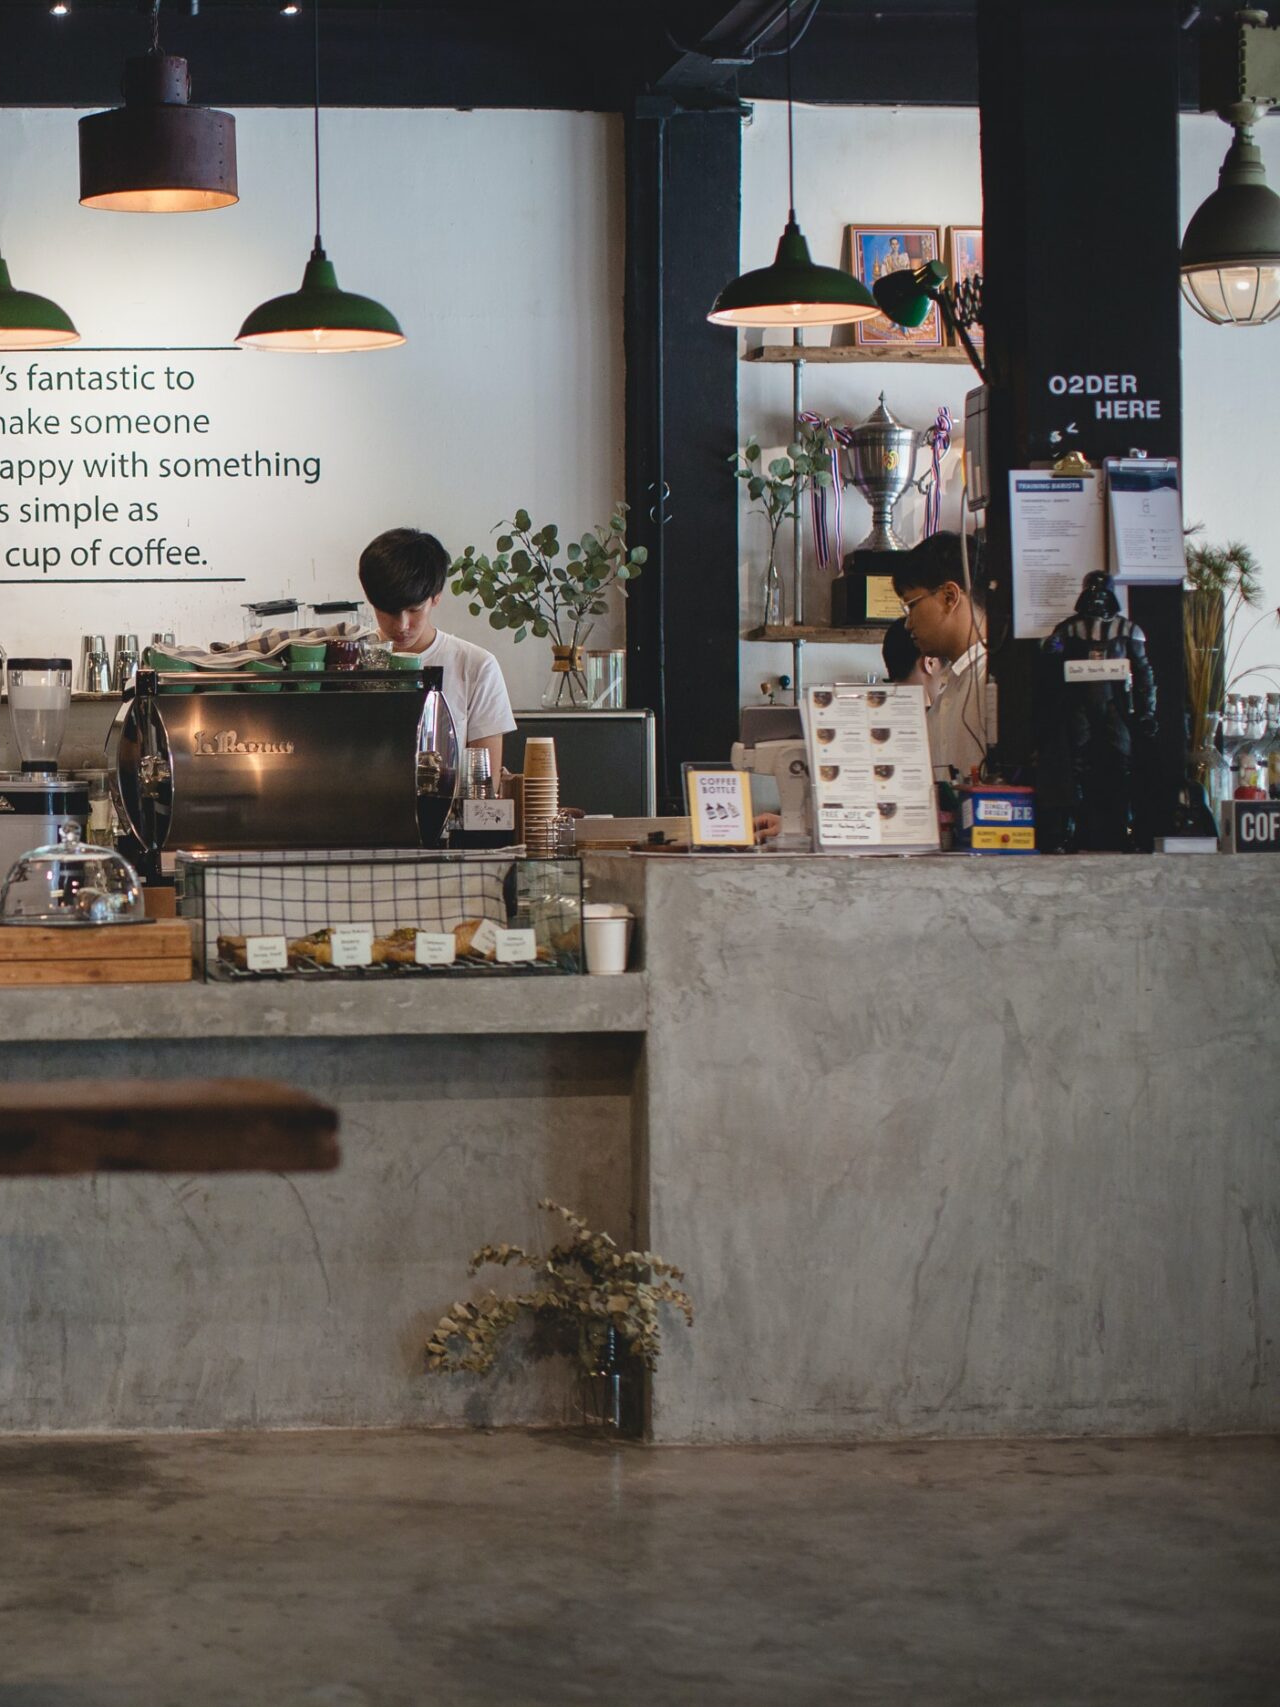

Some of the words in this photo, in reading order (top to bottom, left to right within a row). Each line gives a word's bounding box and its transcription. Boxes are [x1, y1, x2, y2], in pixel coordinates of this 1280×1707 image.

[27, 363, 156, 391] fantastic
[164, 366, 195, 391] to
[1048, 374, 1138, 395] O2DER
[1095, 399, 1162, 419] HERE
[70, 412, 210, 434] someone
[83, 451, 149, 478] with
[159, 450, 321, 484] something
[19, 495, 119, 529] simple
[128, 502, 160, 522] as
[5, 546, 61, 574] cup
[70, 538, 102, 567] of
[109, 537, 208, 567] coffee.
[700, 778, 737, 786] COFFEE
[702, 786, 736, 794] BOTTLE
